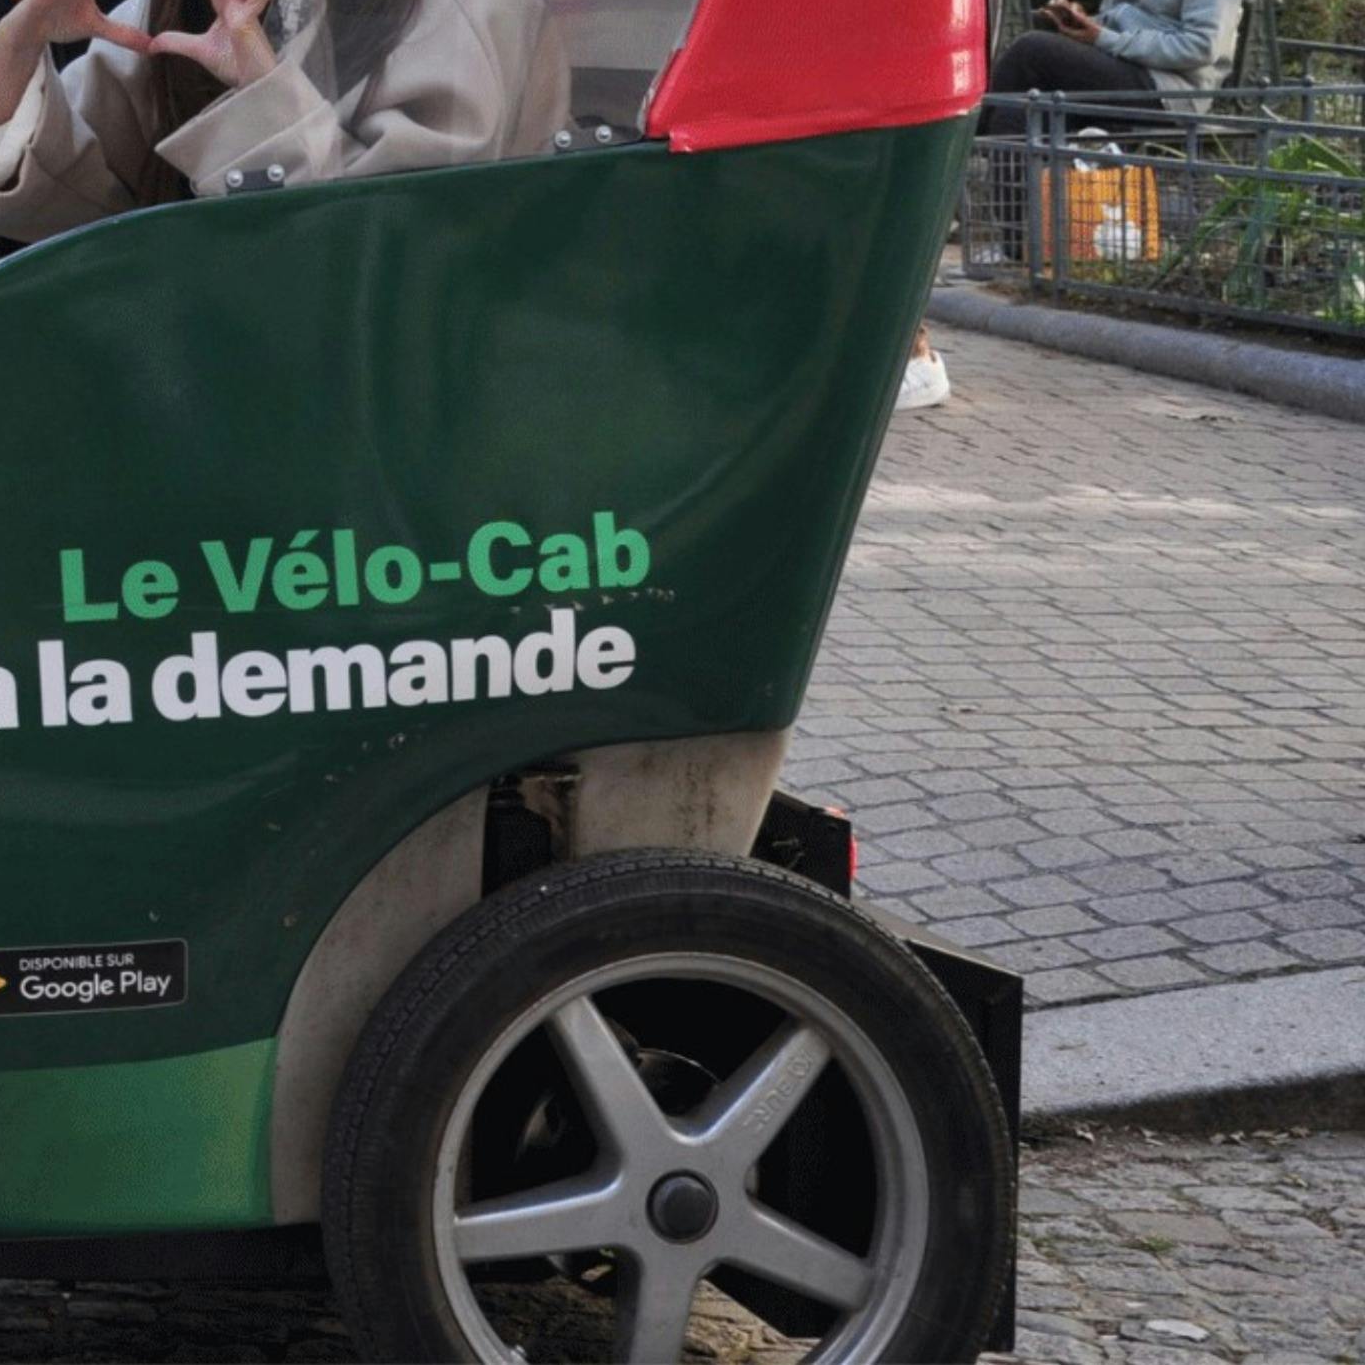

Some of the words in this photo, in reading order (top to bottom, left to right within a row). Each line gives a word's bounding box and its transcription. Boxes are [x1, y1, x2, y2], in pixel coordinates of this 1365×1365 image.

[60, 549, 179, 622] Le
[201, 511, 651, 613] Vélo-Cab
[38, 640, 132, 727] la
[151, 608, 636, 721] demande
[19, 954, 104, 972] DISPONIBLE
[106, 953, 135, 967] SUR
[19, 973, 115, 1003] Google
[119, 970, 172, 997] Play
